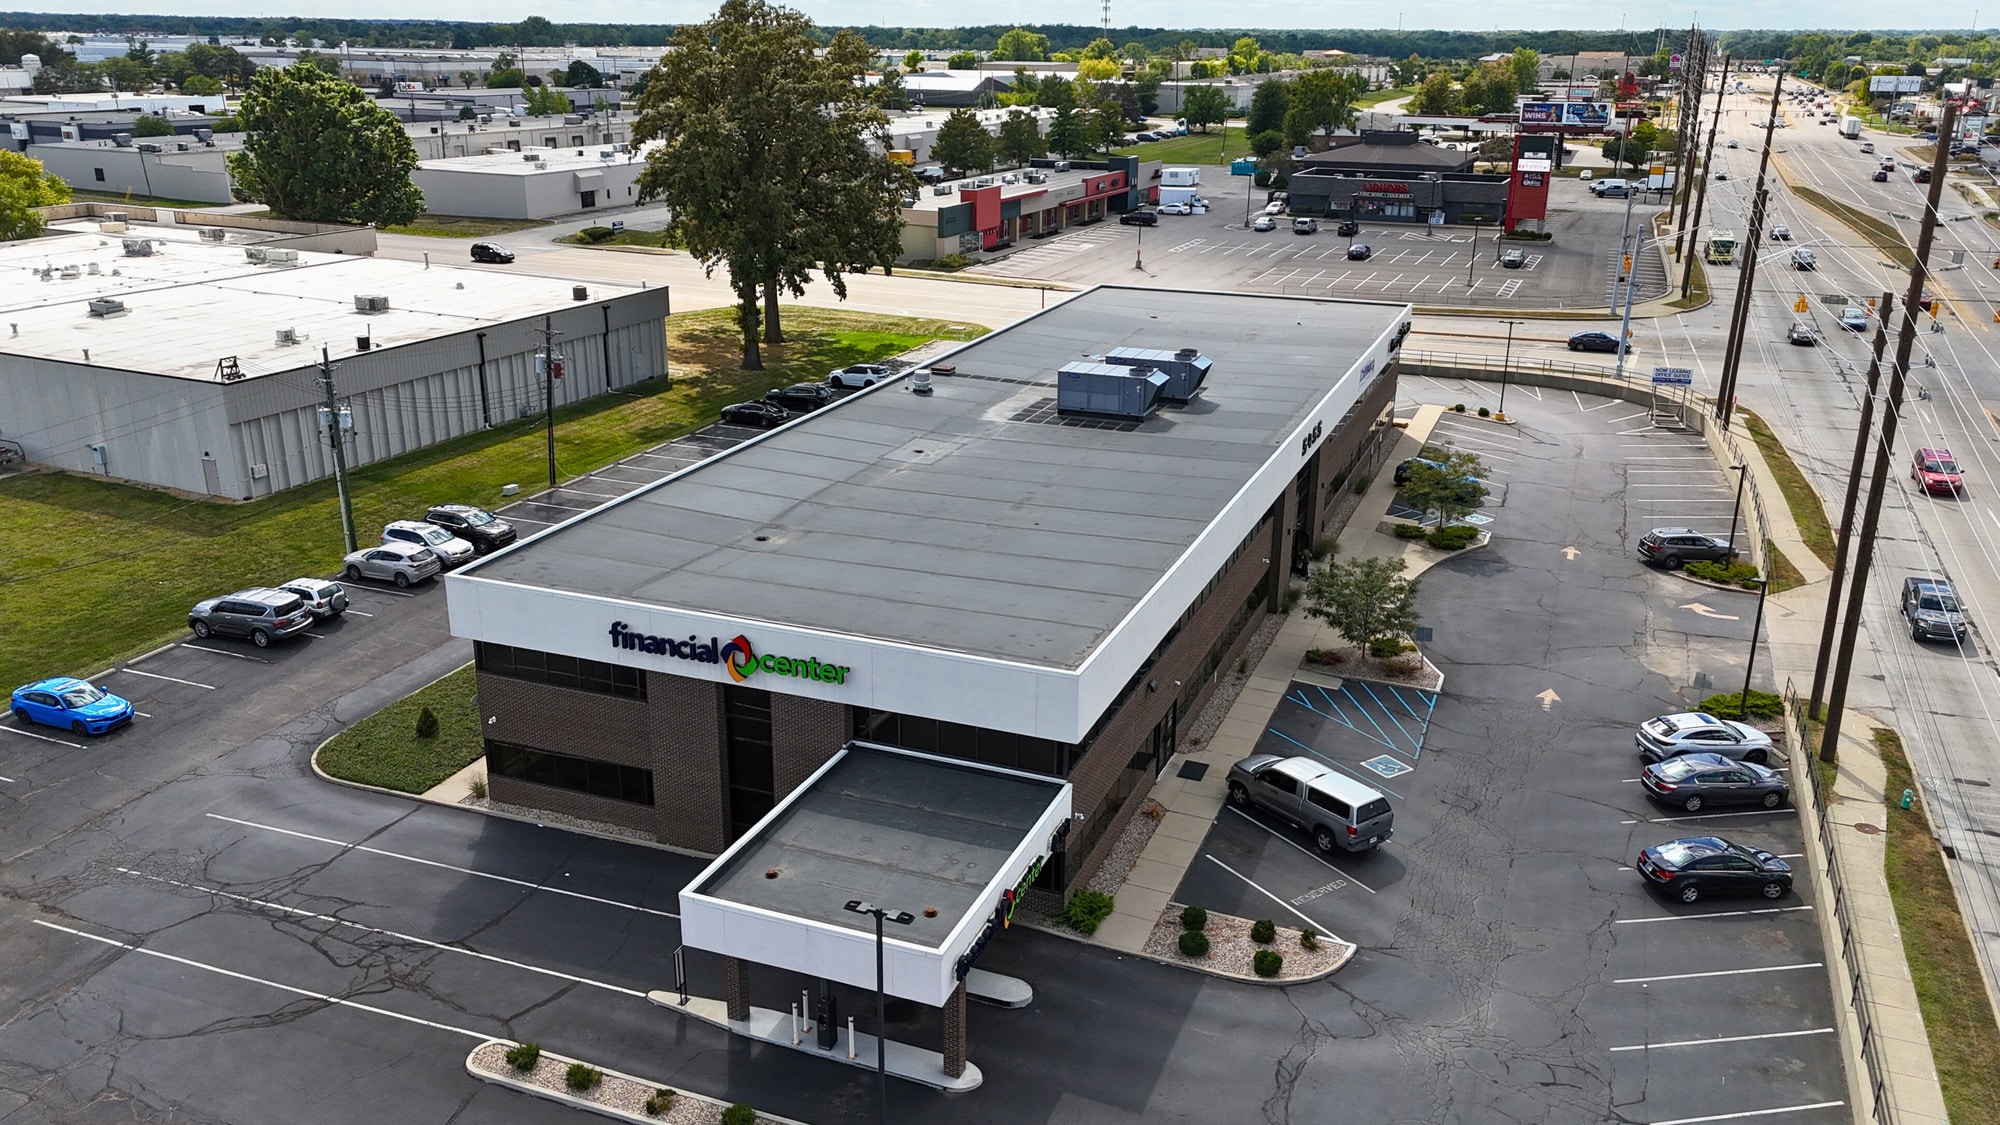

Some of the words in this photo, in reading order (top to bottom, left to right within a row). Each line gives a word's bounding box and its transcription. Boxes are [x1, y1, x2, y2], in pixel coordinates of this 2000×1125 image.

[1363, 183, 1409, 192] LIQUORS
[608, 621, 719, 665] financial
[759, 653, 850, 685] center
[1014, 855, 1044, 903] center
[1290, 879, 1347, 906] RESERVED
